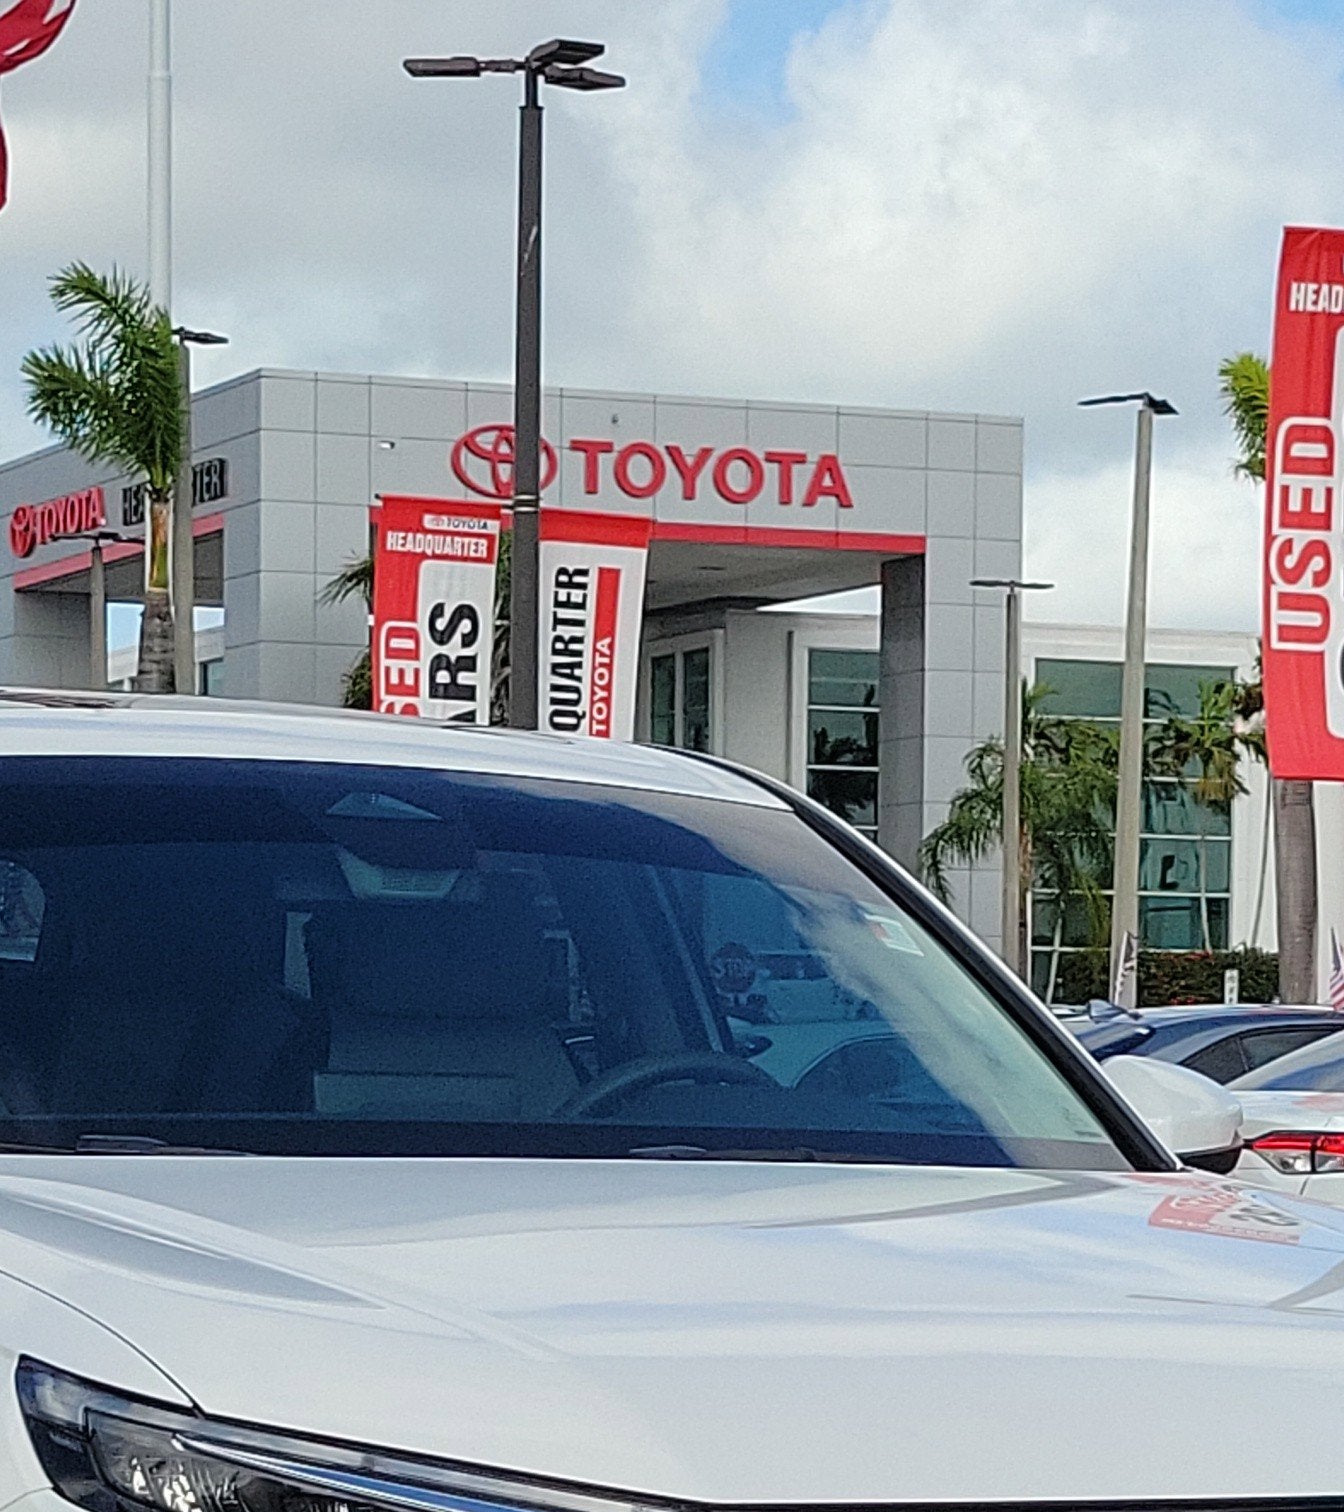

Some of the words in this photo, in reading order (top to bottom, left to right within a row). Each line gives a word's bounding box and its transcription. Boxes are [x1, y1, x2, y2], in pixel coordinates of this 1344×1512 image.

[570, 439, 854, 507] TOYOTA
[35, 486, 104, 545] TOYOTA
[386, 531, 488, 558] HEADQUARTER
[447, 518, 488, 530] TOYOTA
[1270, 418, 1336, 651] USED
[591, 637, 612, 734] TOYOTA
